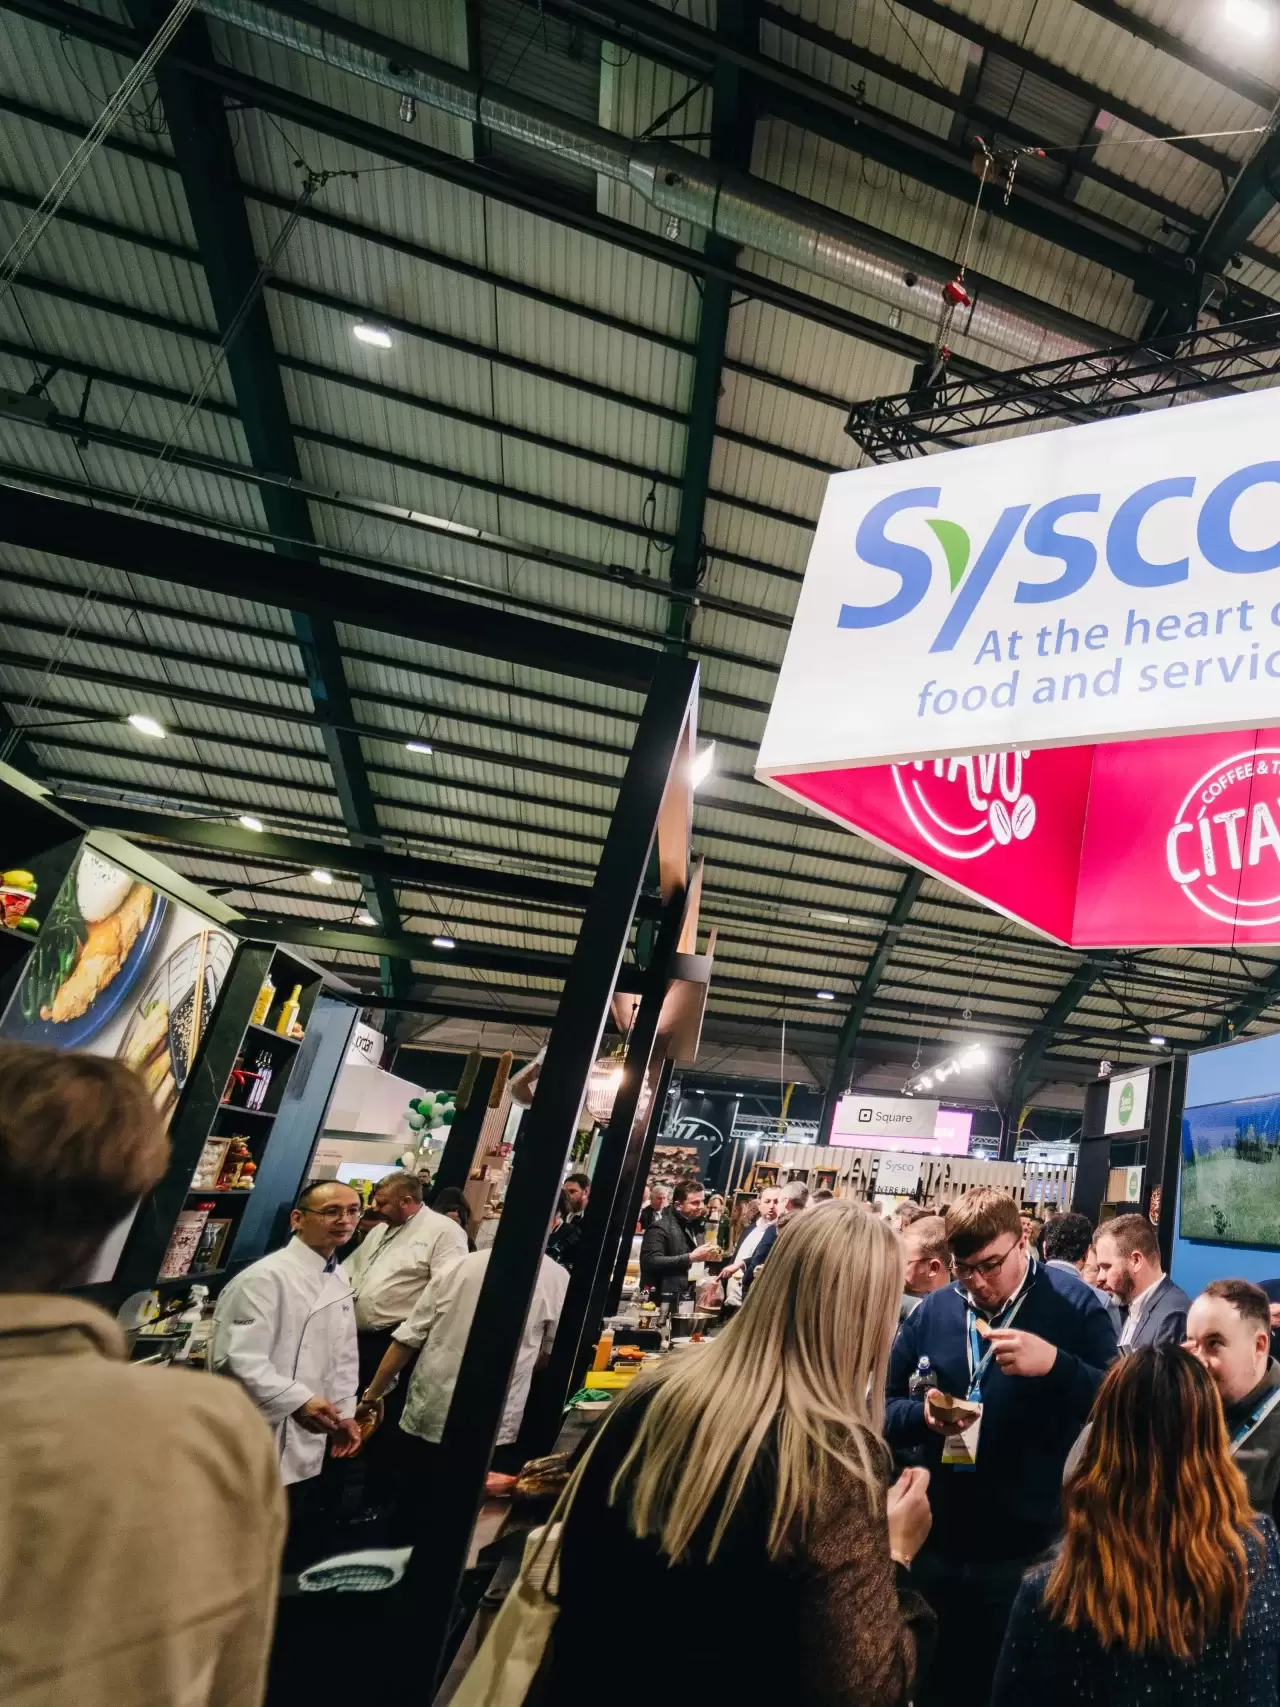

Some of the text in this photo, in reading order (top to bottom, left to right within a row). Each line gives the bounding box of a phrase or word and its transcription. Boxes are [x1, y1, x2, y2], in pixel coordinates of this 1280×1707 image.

[974, 627, 1023, 664] At
[1034, 618, 1109, 658] the
[1124, 599, 1253, 645] heart
[917, 663, 1018, 718] food
[1033, 651, 1121, 704] and
[1201, 762, 1254, 804] COFFEE
[1256, 760, 1269, 775] &
[875, 1111, 913, 1124] Square
[885, 1159, 915, 1173] Sysco
